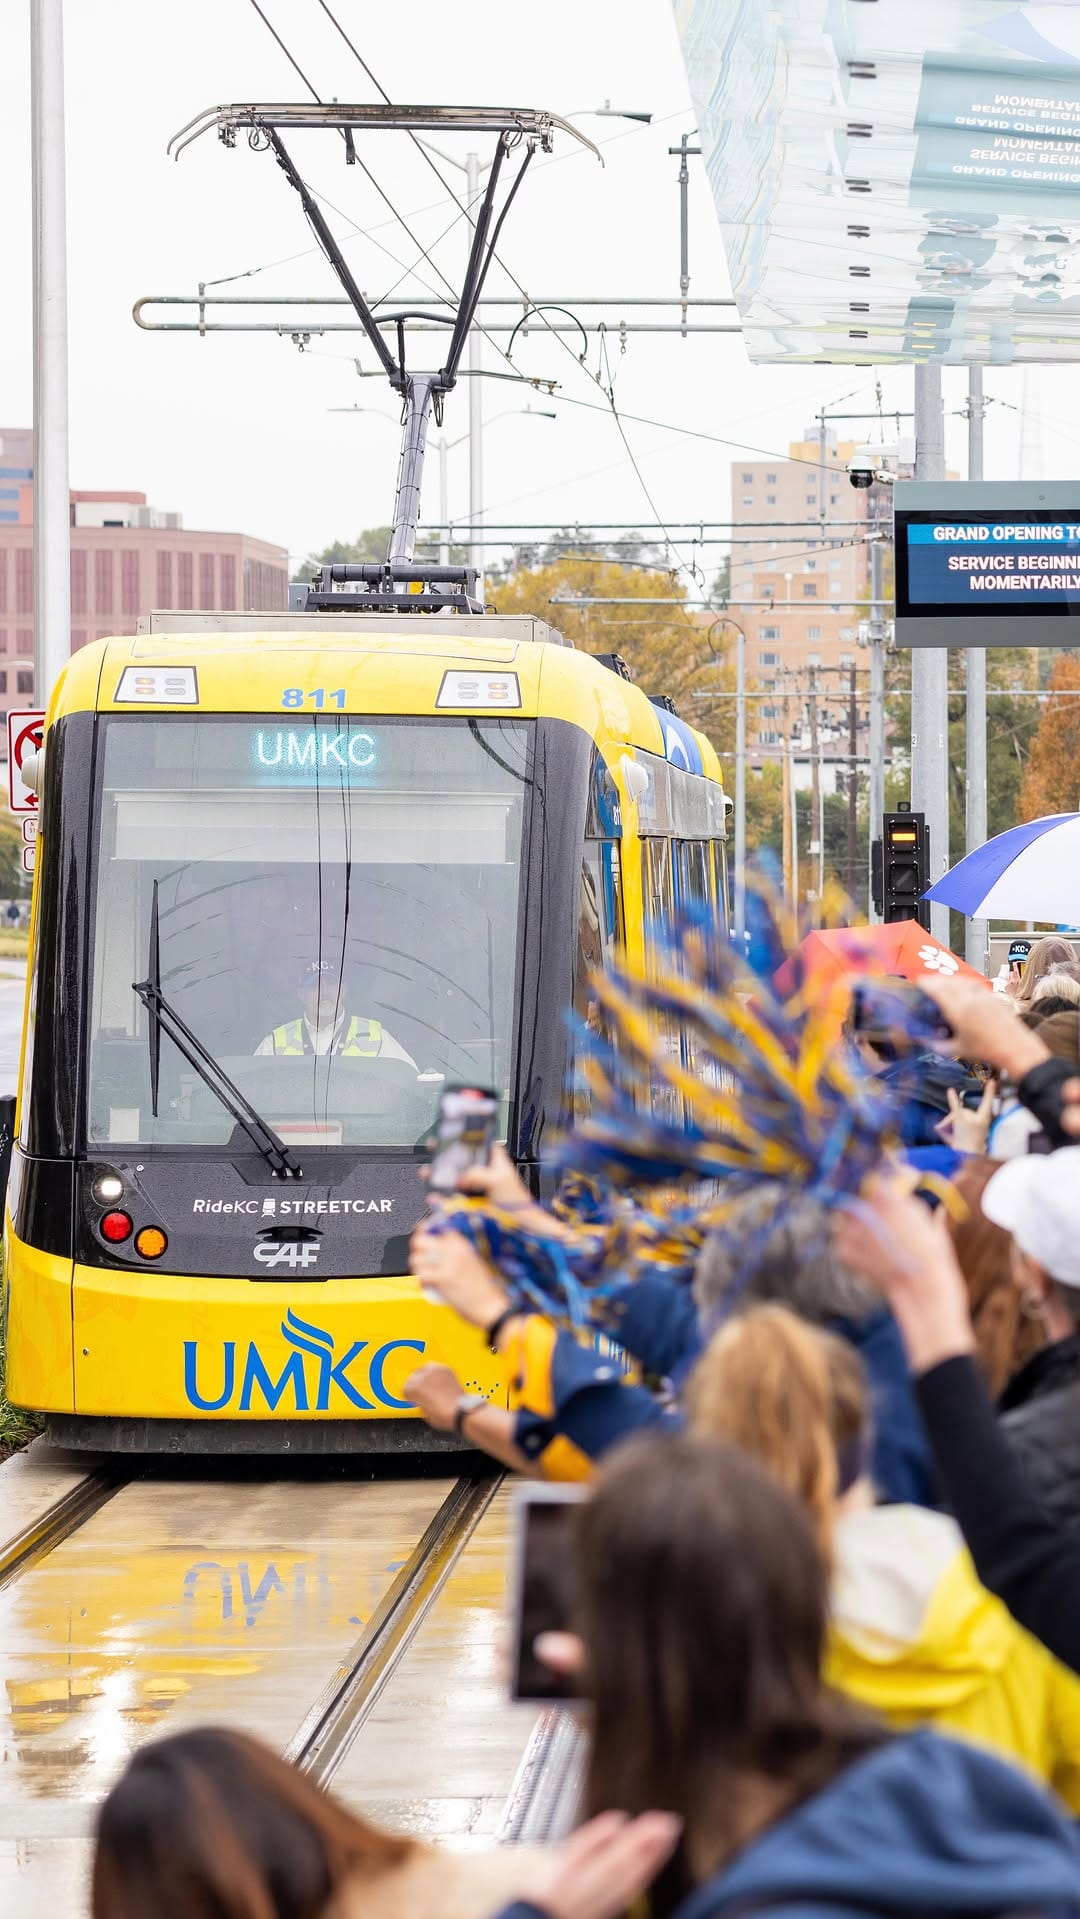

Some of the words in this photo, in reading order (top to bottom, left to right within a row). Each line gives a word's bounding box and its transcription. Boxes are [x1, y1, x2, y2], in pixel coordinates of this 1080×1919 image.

[933, 526, 989, 541] GRAND
[992, 526, 1064, 540] OPENING
[948, 556, 1014, 570] SERVICE
[969, 575, 1080, 590] MOMENTARILY
[281, 688, 346, 709] 811
[257, 732, 375, 766] UMKC
[1015, 945, 1026, 953] KC
[311, 960, 329, 971] KC
[193, 1199, 259, 1214] RideKC
[280, 1200, 392, 1214] STREETCAR
[253, 1243, 320, 1268] CAF
[183, 1308, 426, 1411] UMKC
